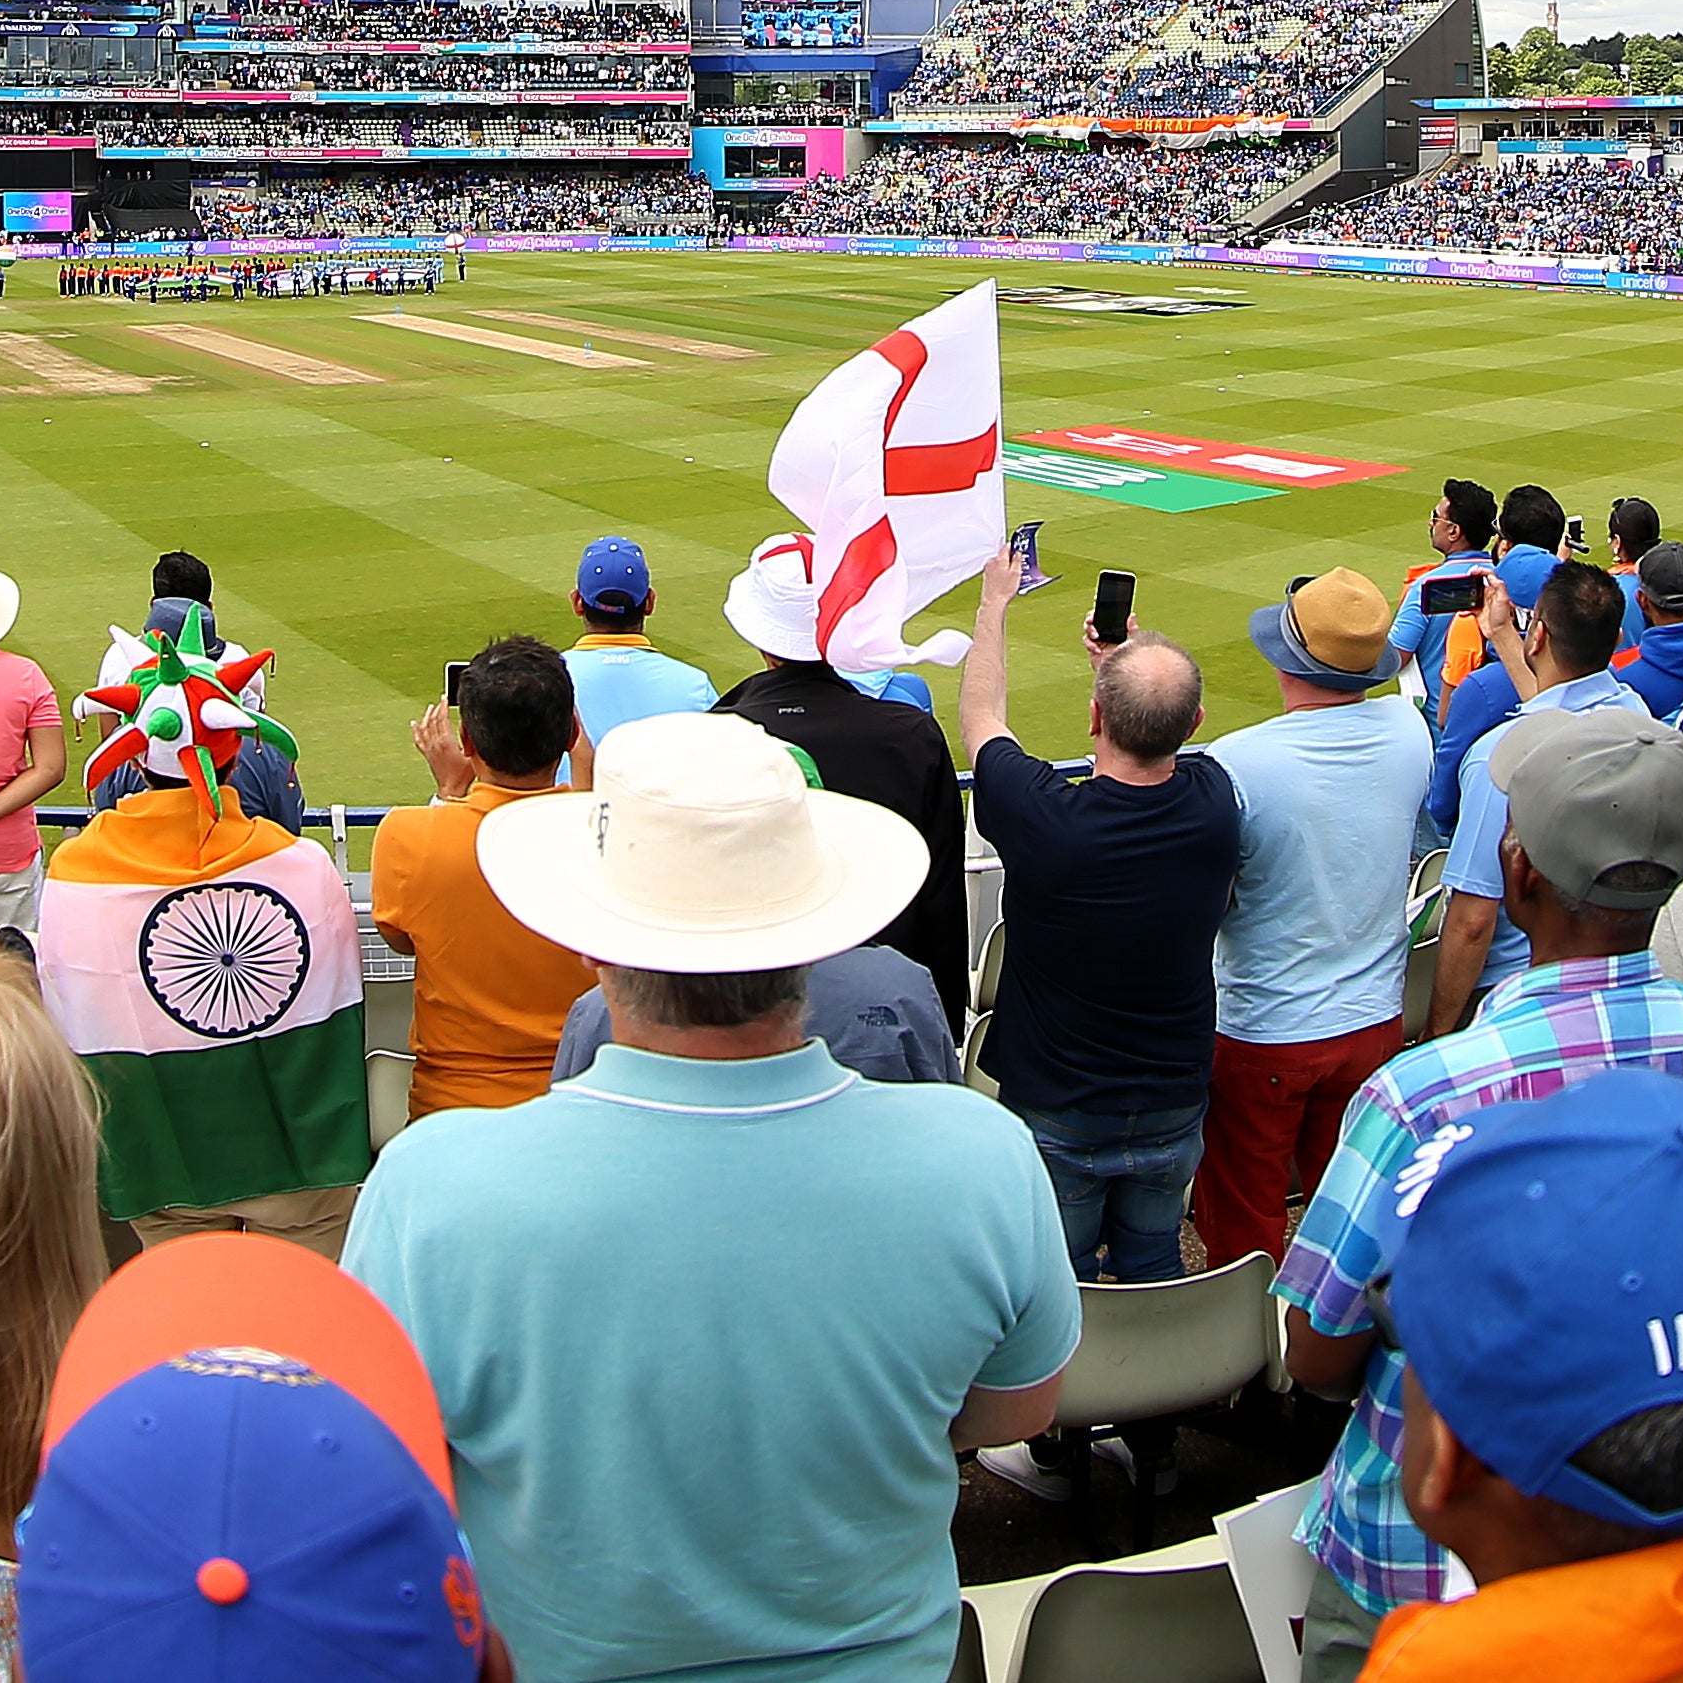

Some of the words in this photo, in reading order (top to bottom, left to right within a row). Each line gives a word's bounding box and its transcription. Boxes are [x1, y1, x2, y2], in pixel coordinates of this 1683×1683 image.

[1135, 119, 1192, 131] BHARAT
[1385, 260, 1415, 273] unicef
[1621, 274, 1655, 288] unicef
